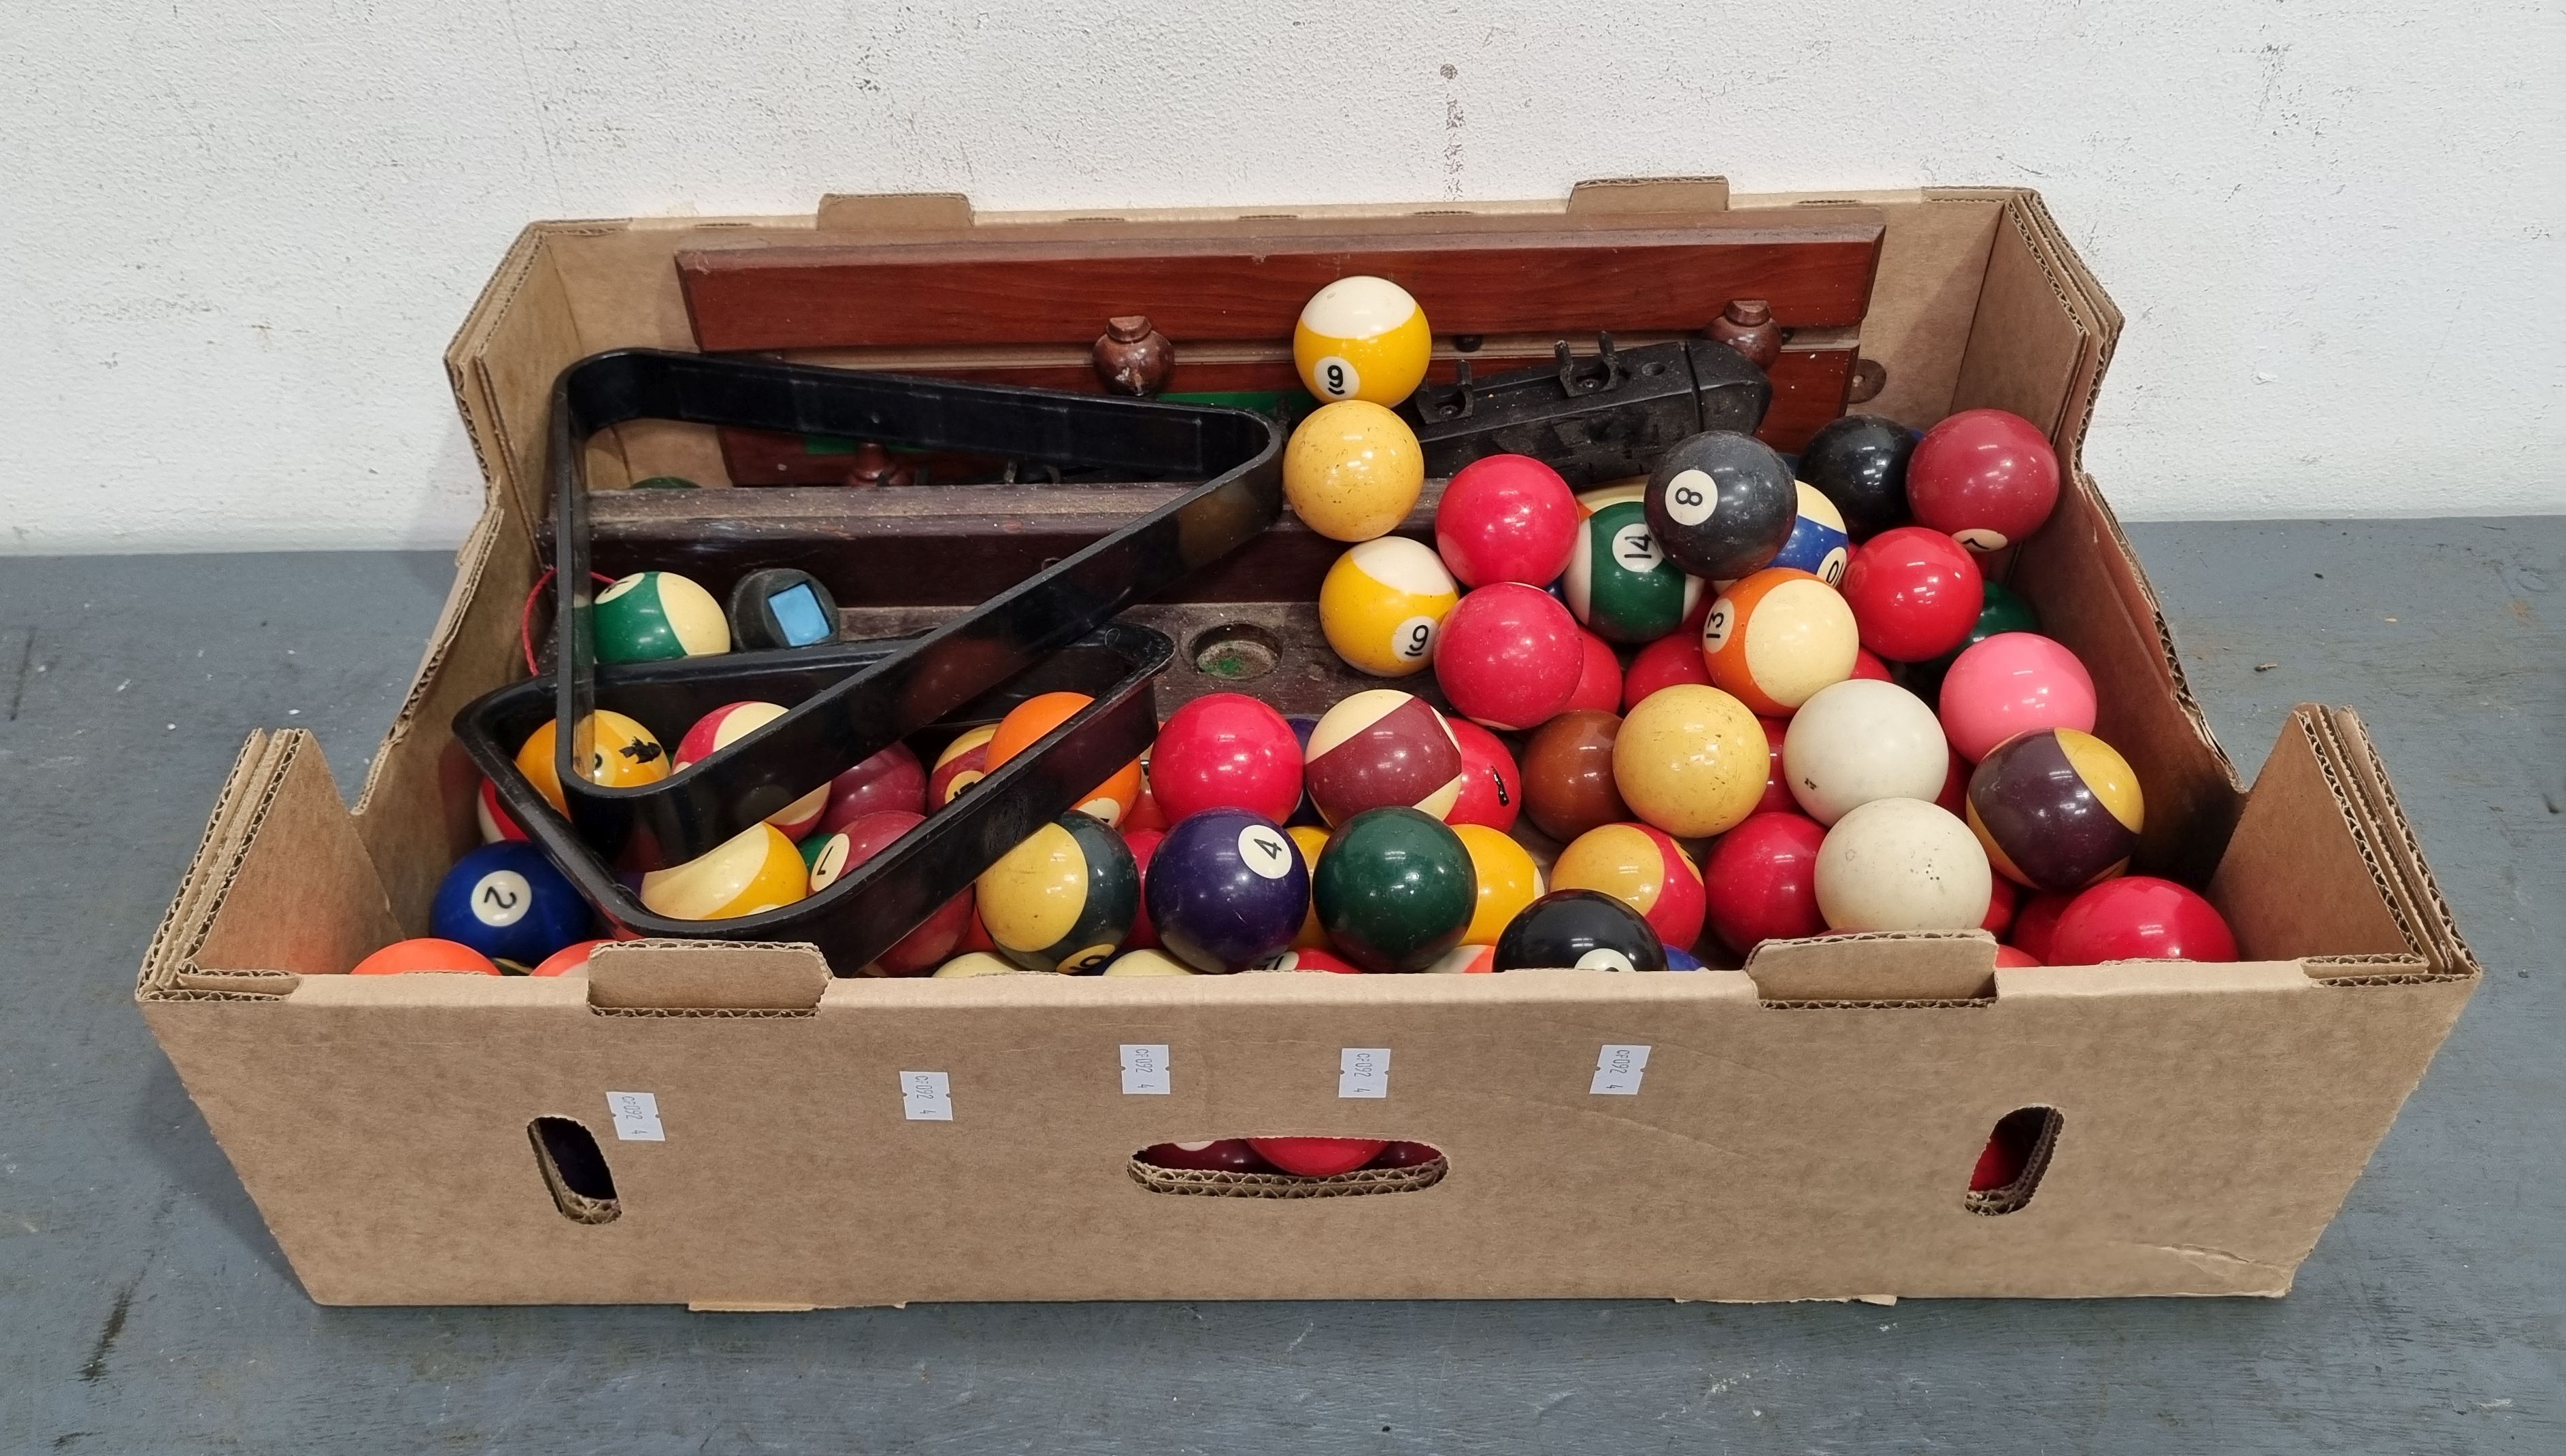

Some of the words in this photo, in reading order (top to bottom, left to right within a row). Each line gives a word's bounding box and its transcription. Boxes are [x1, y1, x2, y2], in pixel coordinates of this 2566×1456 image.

[1327, 365, 1344, 389] 9
[1676, 487, 1703, 506] 8
[1624, 534, 1652, 558] 14
[1408, 624, 1429, 652] 9
[1706, 613, 1724, 639] 13
[1254, 838, 1282, 860] 4
[484, 886, 517, 909] 2
